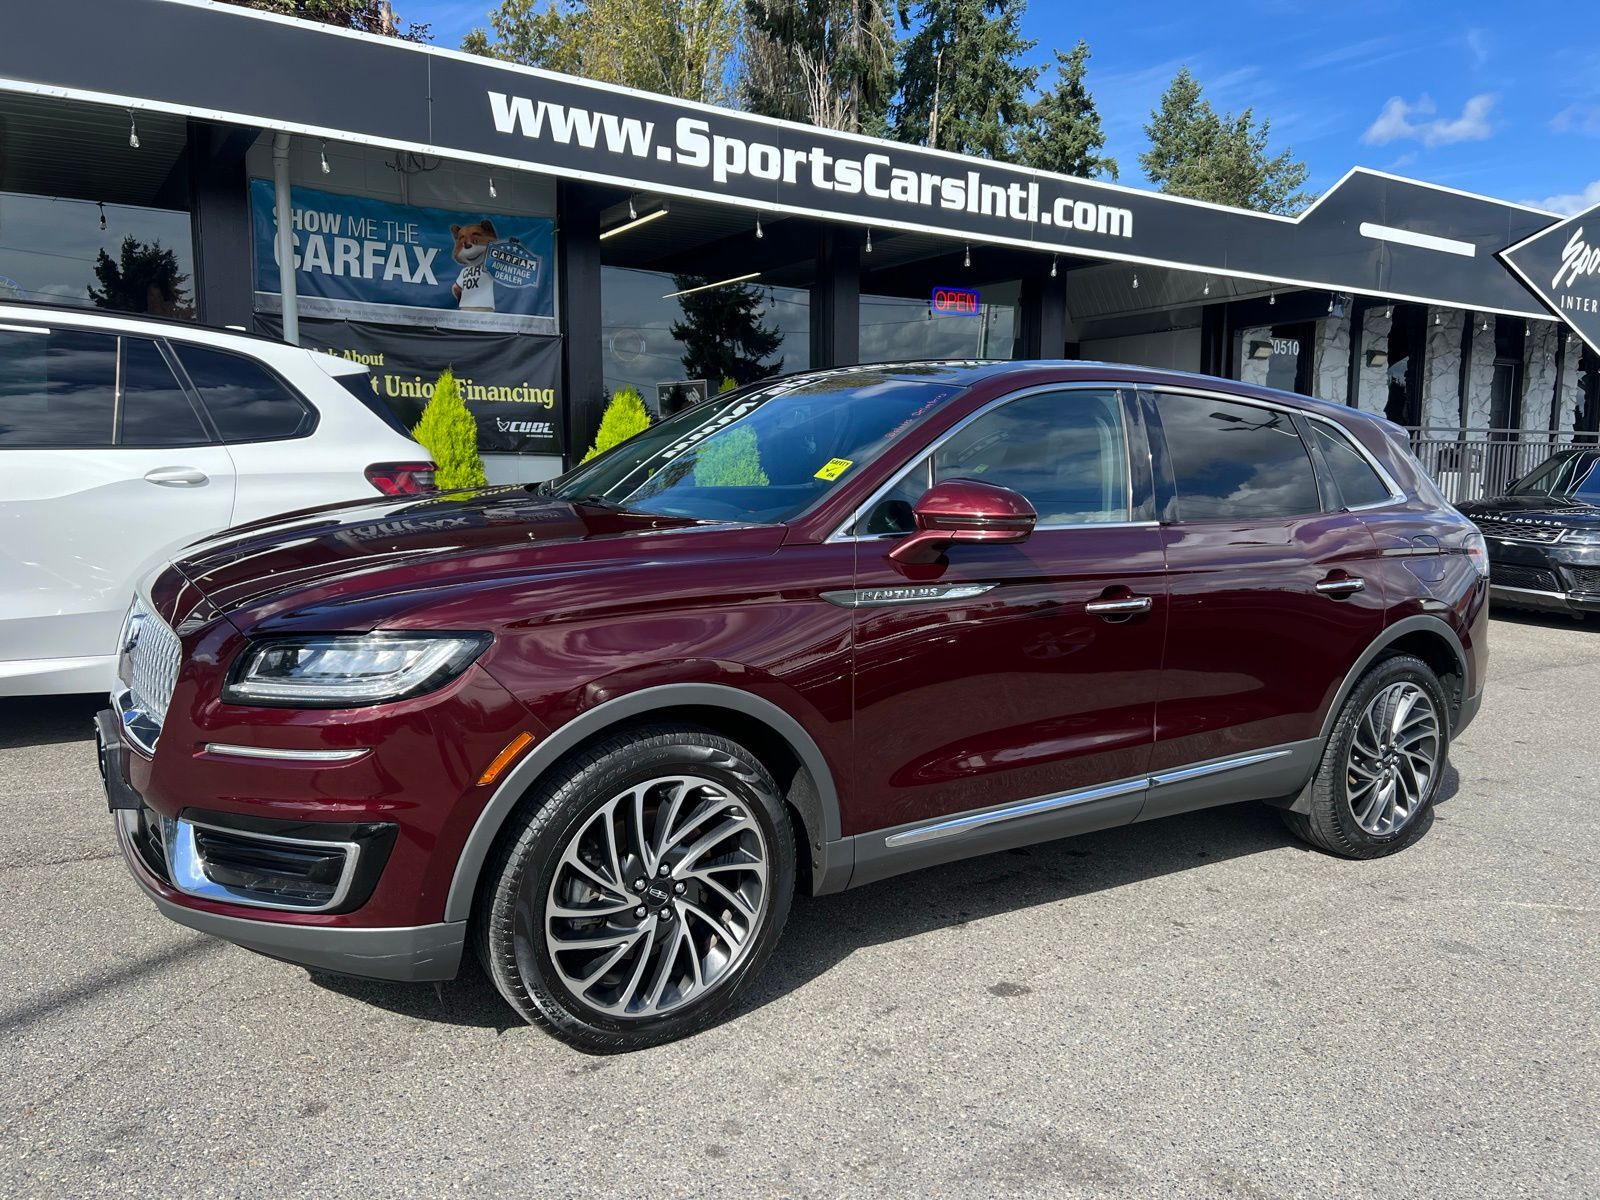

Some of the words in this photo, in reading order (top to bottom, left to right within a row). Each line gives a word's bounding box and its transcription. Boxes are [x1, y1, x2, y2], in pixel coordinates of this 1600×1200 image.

[487, 91, 1133, 238] www.SportsCarsIntl.com
[348, 216, 378, 239] ME
[383, 220, 418, 244] THE
[491, 249, 536, 271] CARFAX
[1551, 226, 1600, 290] Spo
[463, 266, 481, 278] CAR
[492, 261, 531, 279] ADVANTAGE
[495, 271, 522, 285] DEALER
[463, 278, 480, 290] FOX
[935, 290, 977, 313] OPEN
[1561, 294, 1598, 313] INTER
[385, 375, 439, 399] Unio
[453, 378, 555, 410] Financing
[1469, 513, 1509, 522] RANGE
[1515, 518, 1563, 526] ROVER
[862, 588, 938, 600] NAUTILUS
